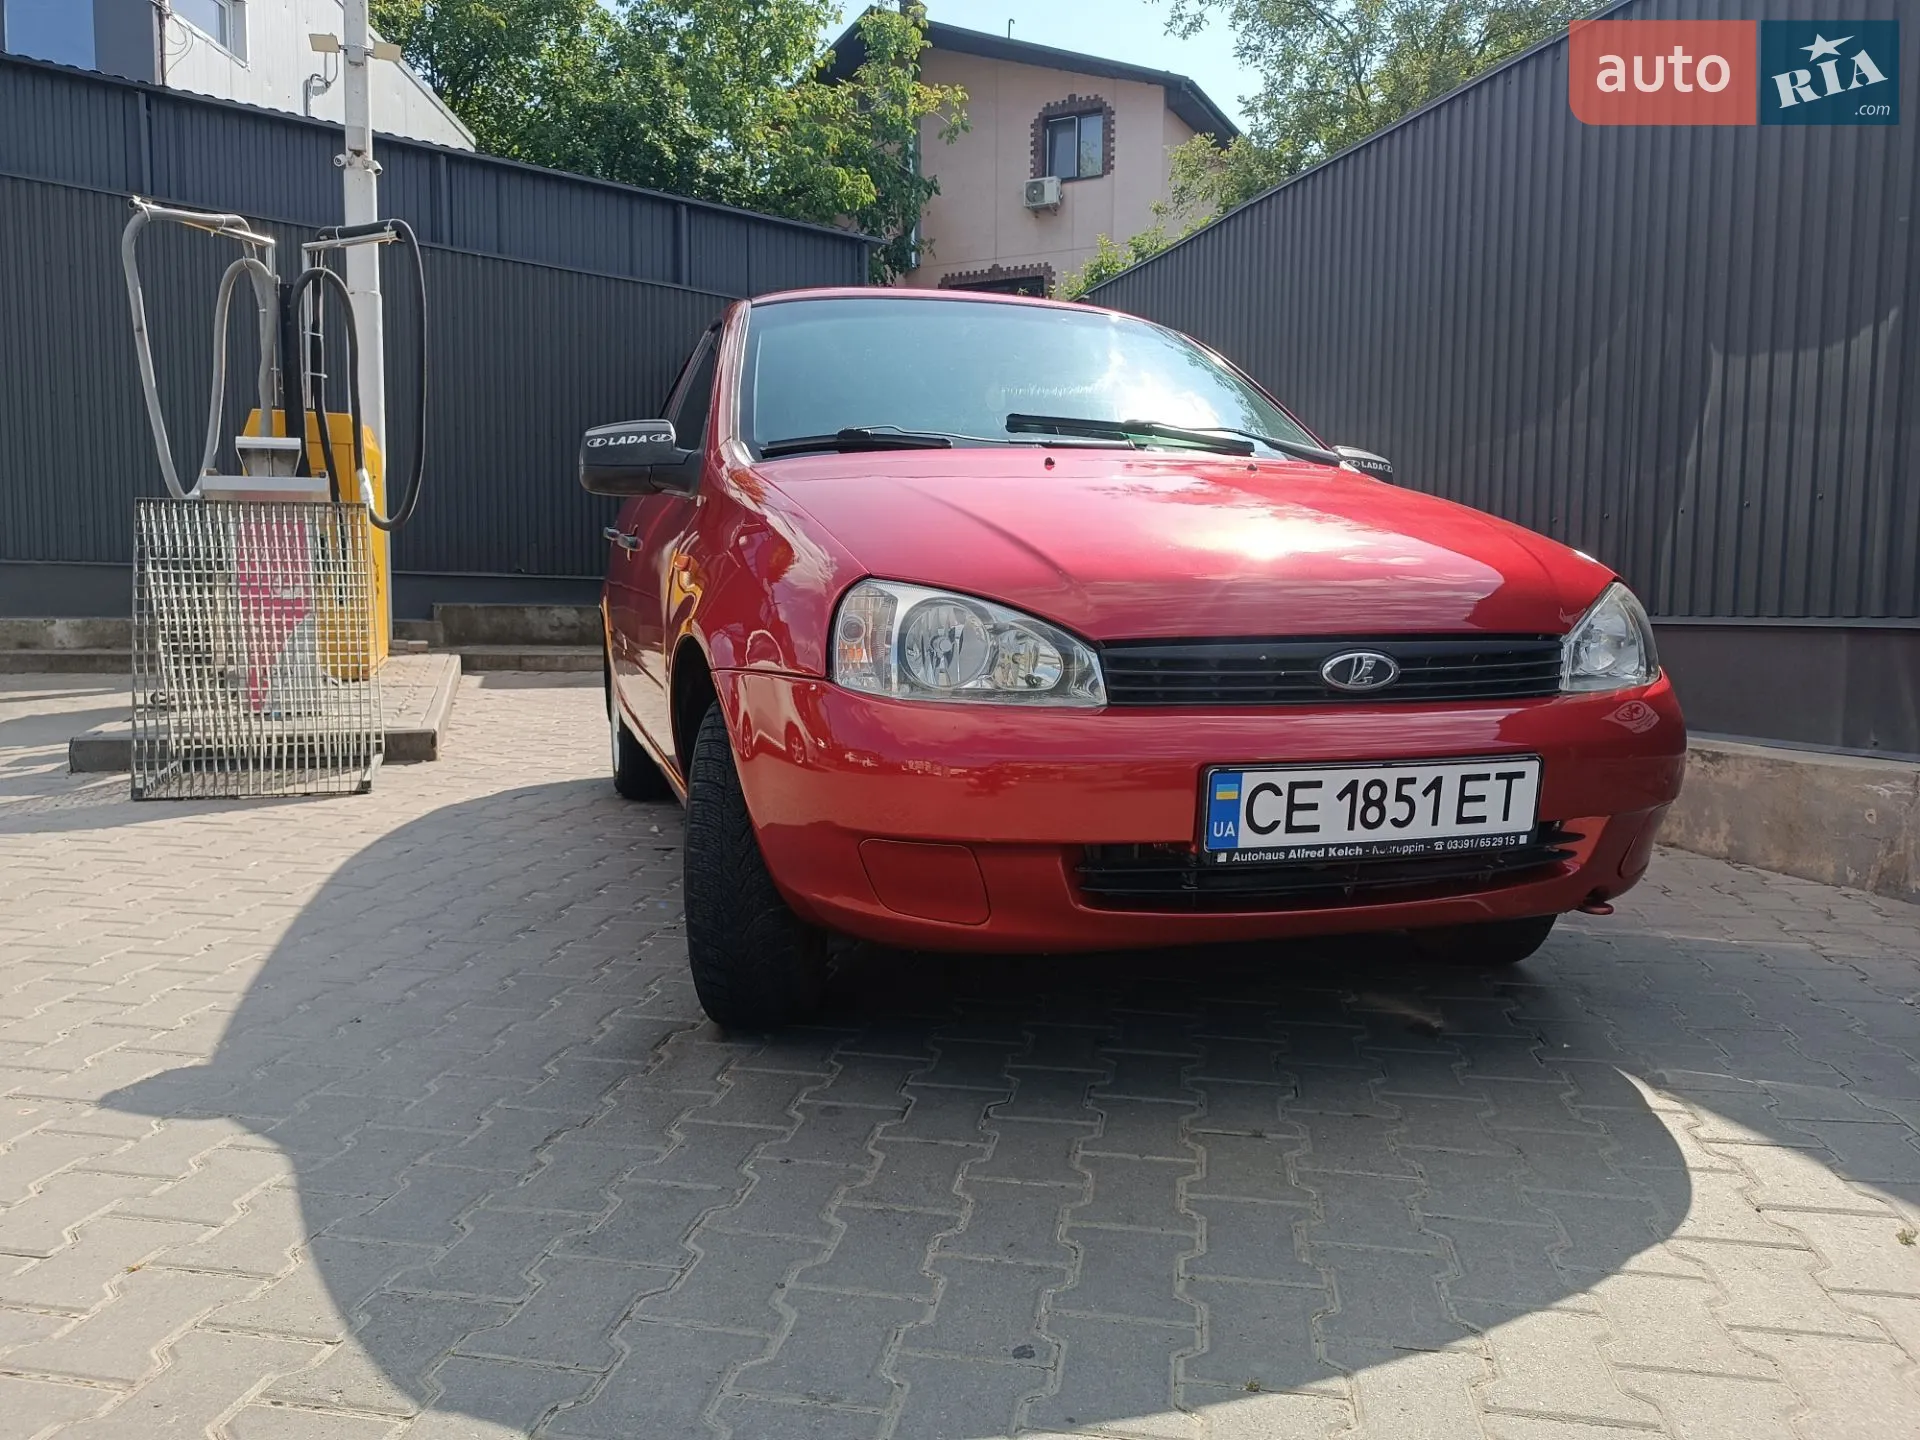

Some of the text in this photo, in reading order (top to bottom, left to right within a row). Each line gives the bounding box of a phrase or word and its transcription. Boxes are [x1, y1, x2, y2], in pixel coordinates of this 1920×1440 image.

[608, 434, 647, 446] LADA
[1361, 460, 1384, 471] LADA
[1245, 770, 1527, 836] CE 1851 ET
[1213, 821, 1236, 838] UA
[1232, 850, 1286, 863] Autohaus
[1288, 847, 1325, 860] Alfred
[1328, 845, 1363, 858] Kelch
